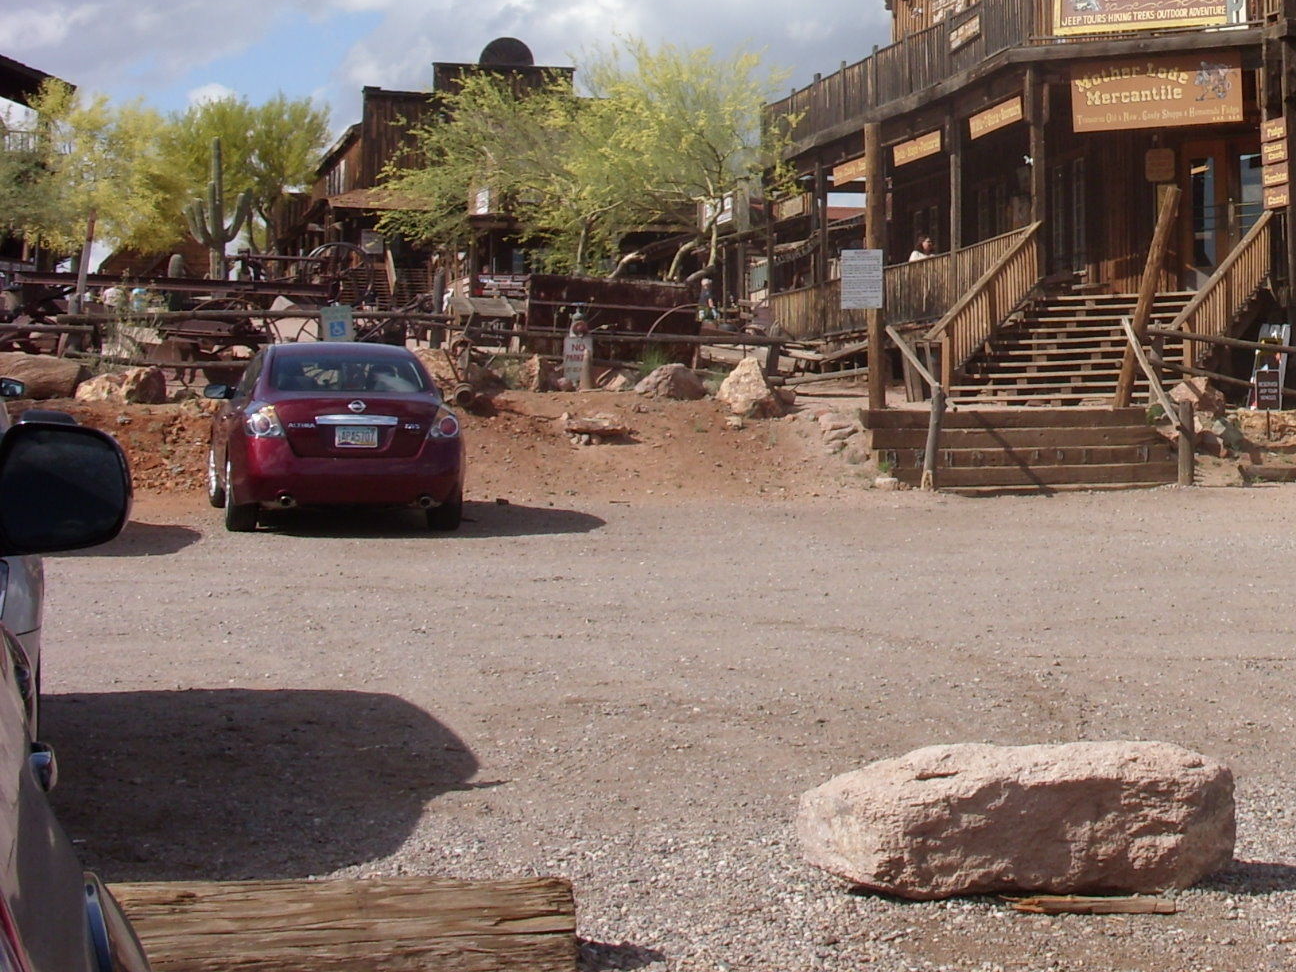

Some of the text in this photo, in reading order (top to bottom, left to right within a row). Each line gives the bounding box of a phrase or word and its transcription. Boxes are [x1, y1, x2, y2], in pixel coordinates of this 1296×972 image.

[1062, 15, 1081, 26] JEEP
[1083, 14, 1106, 24] TOURS
[1189, 5, 1226, 17] ADVENTURE
[1075, 63, 1189, 93] Mother Lode
[1086, 85, 1183, 105] Mercantile
[571, 343, 585, 351] NO
